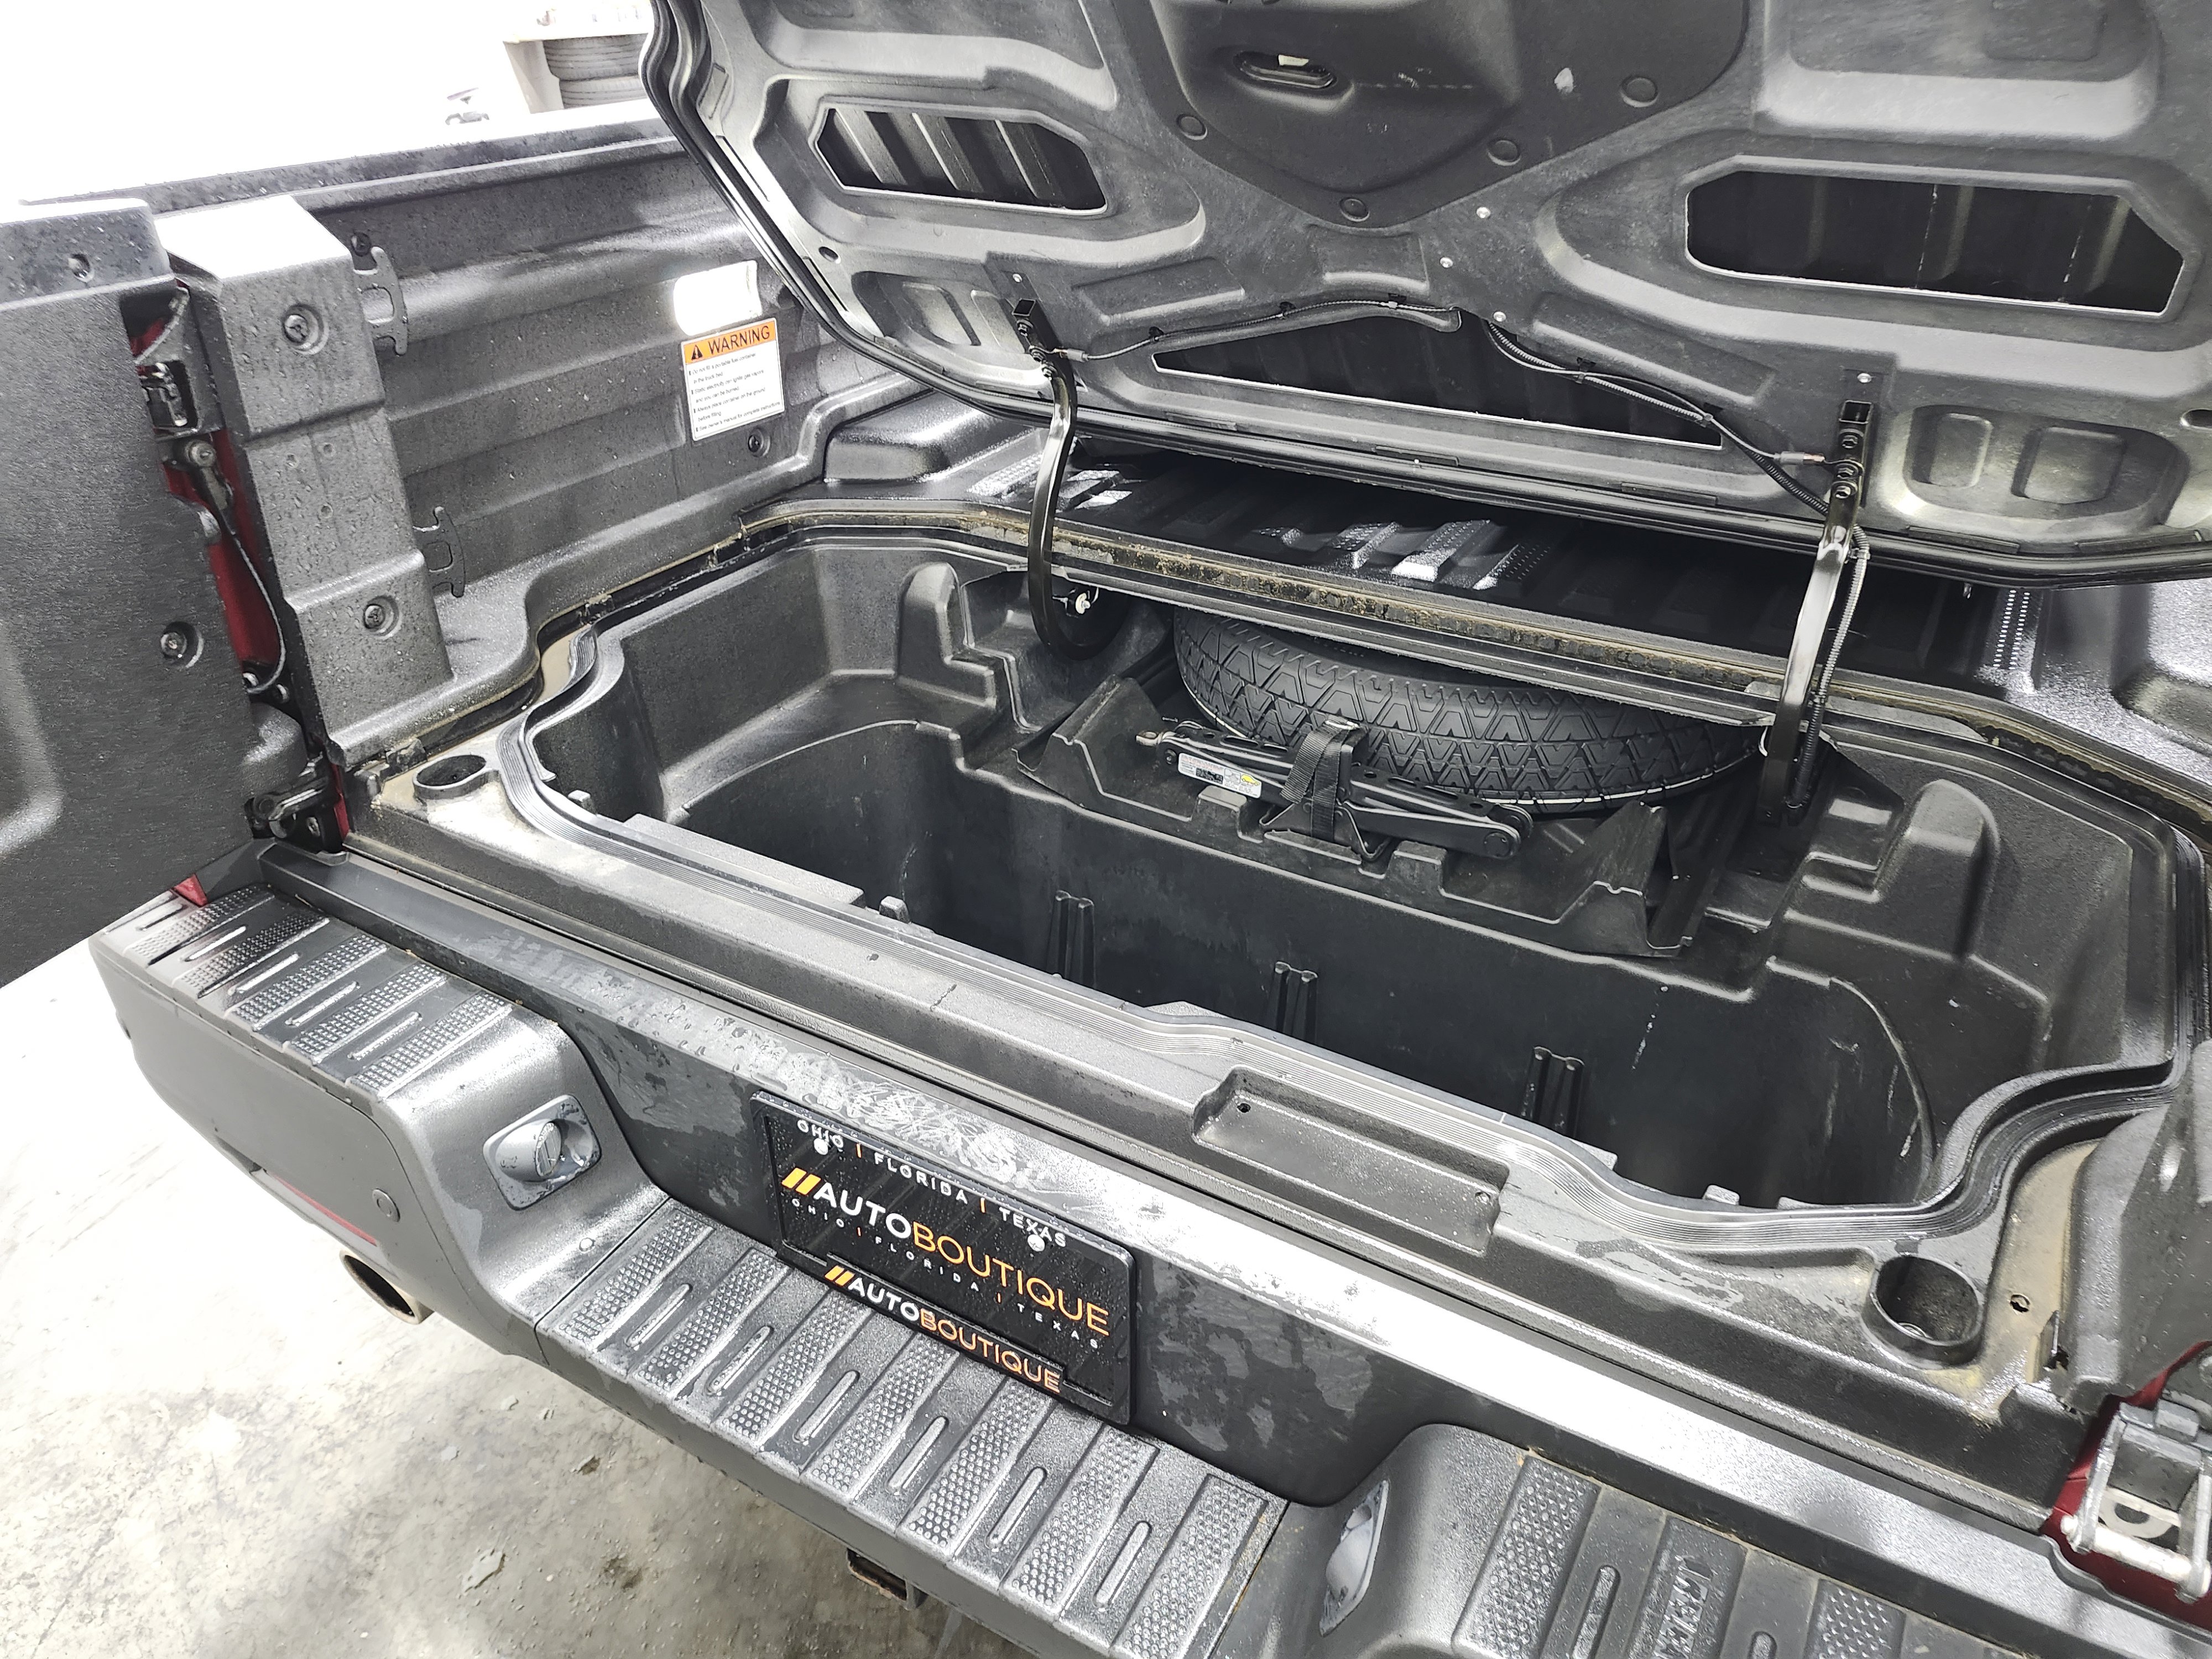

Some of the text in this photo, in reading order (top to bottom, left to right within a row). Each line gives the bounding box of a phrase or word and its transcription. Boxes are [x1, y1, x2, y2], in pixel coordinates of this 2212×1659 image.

[708, 325, 770, 354] WARNING
[797, 1120, 1067, 1247] OHIO FLORIDA TEXAS
[791, 1198, 1098, 1349] OHIO FLORIDA TEXAS
[813, 1182, 1109, 1336] AUTOBOUTIQUE
[847, 1277, 1061, 1394] AUTOBOUTIQUE
